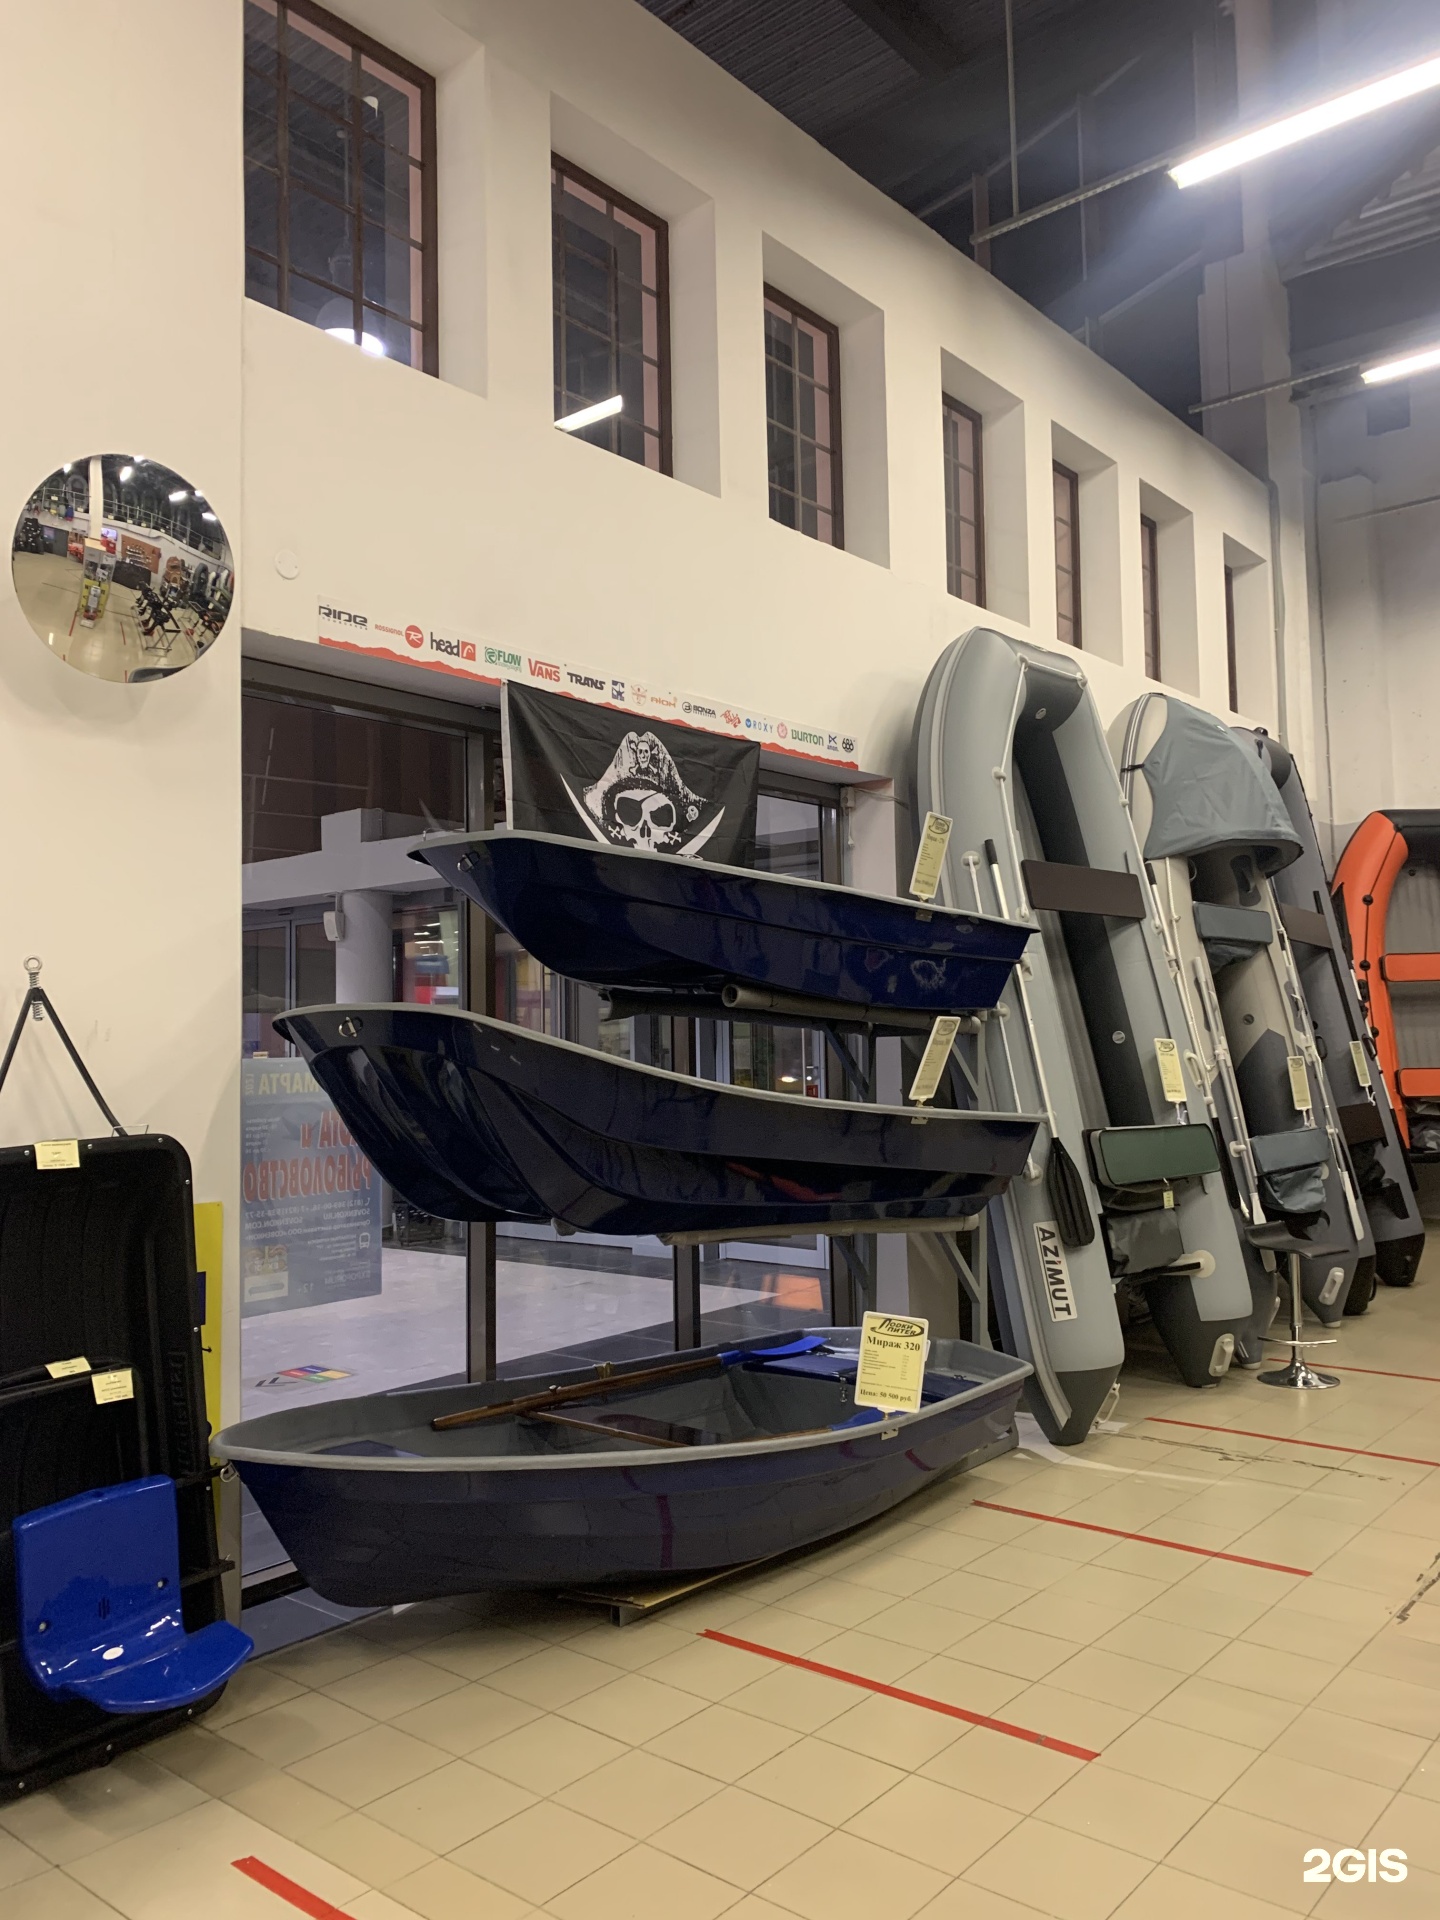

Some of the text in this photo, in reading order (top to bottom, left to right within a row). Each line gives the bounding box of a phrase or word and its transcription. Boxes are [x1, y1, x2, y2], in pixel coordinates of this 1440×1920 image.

[318, 604, 368, 627] RIDE
[374, 623, 404, 637] ROSSIGNOL
[430, 632, 460, 658] head
[497, 650, 522, 667] FLOW
[528, 658, 561, 682] VANS
[567, 672, 606, 691] TRANS
[692, 704, 716, 716] BONZA
[752, 720, 774, 734] ROXY
[791, 728, 825, 747] BURTON
[1038, 1226, 1072, 1317] AZIMUT
[867, 1336, 921, 1351] Мираж 320
[860, 1389, 878, 1397] Цена:
